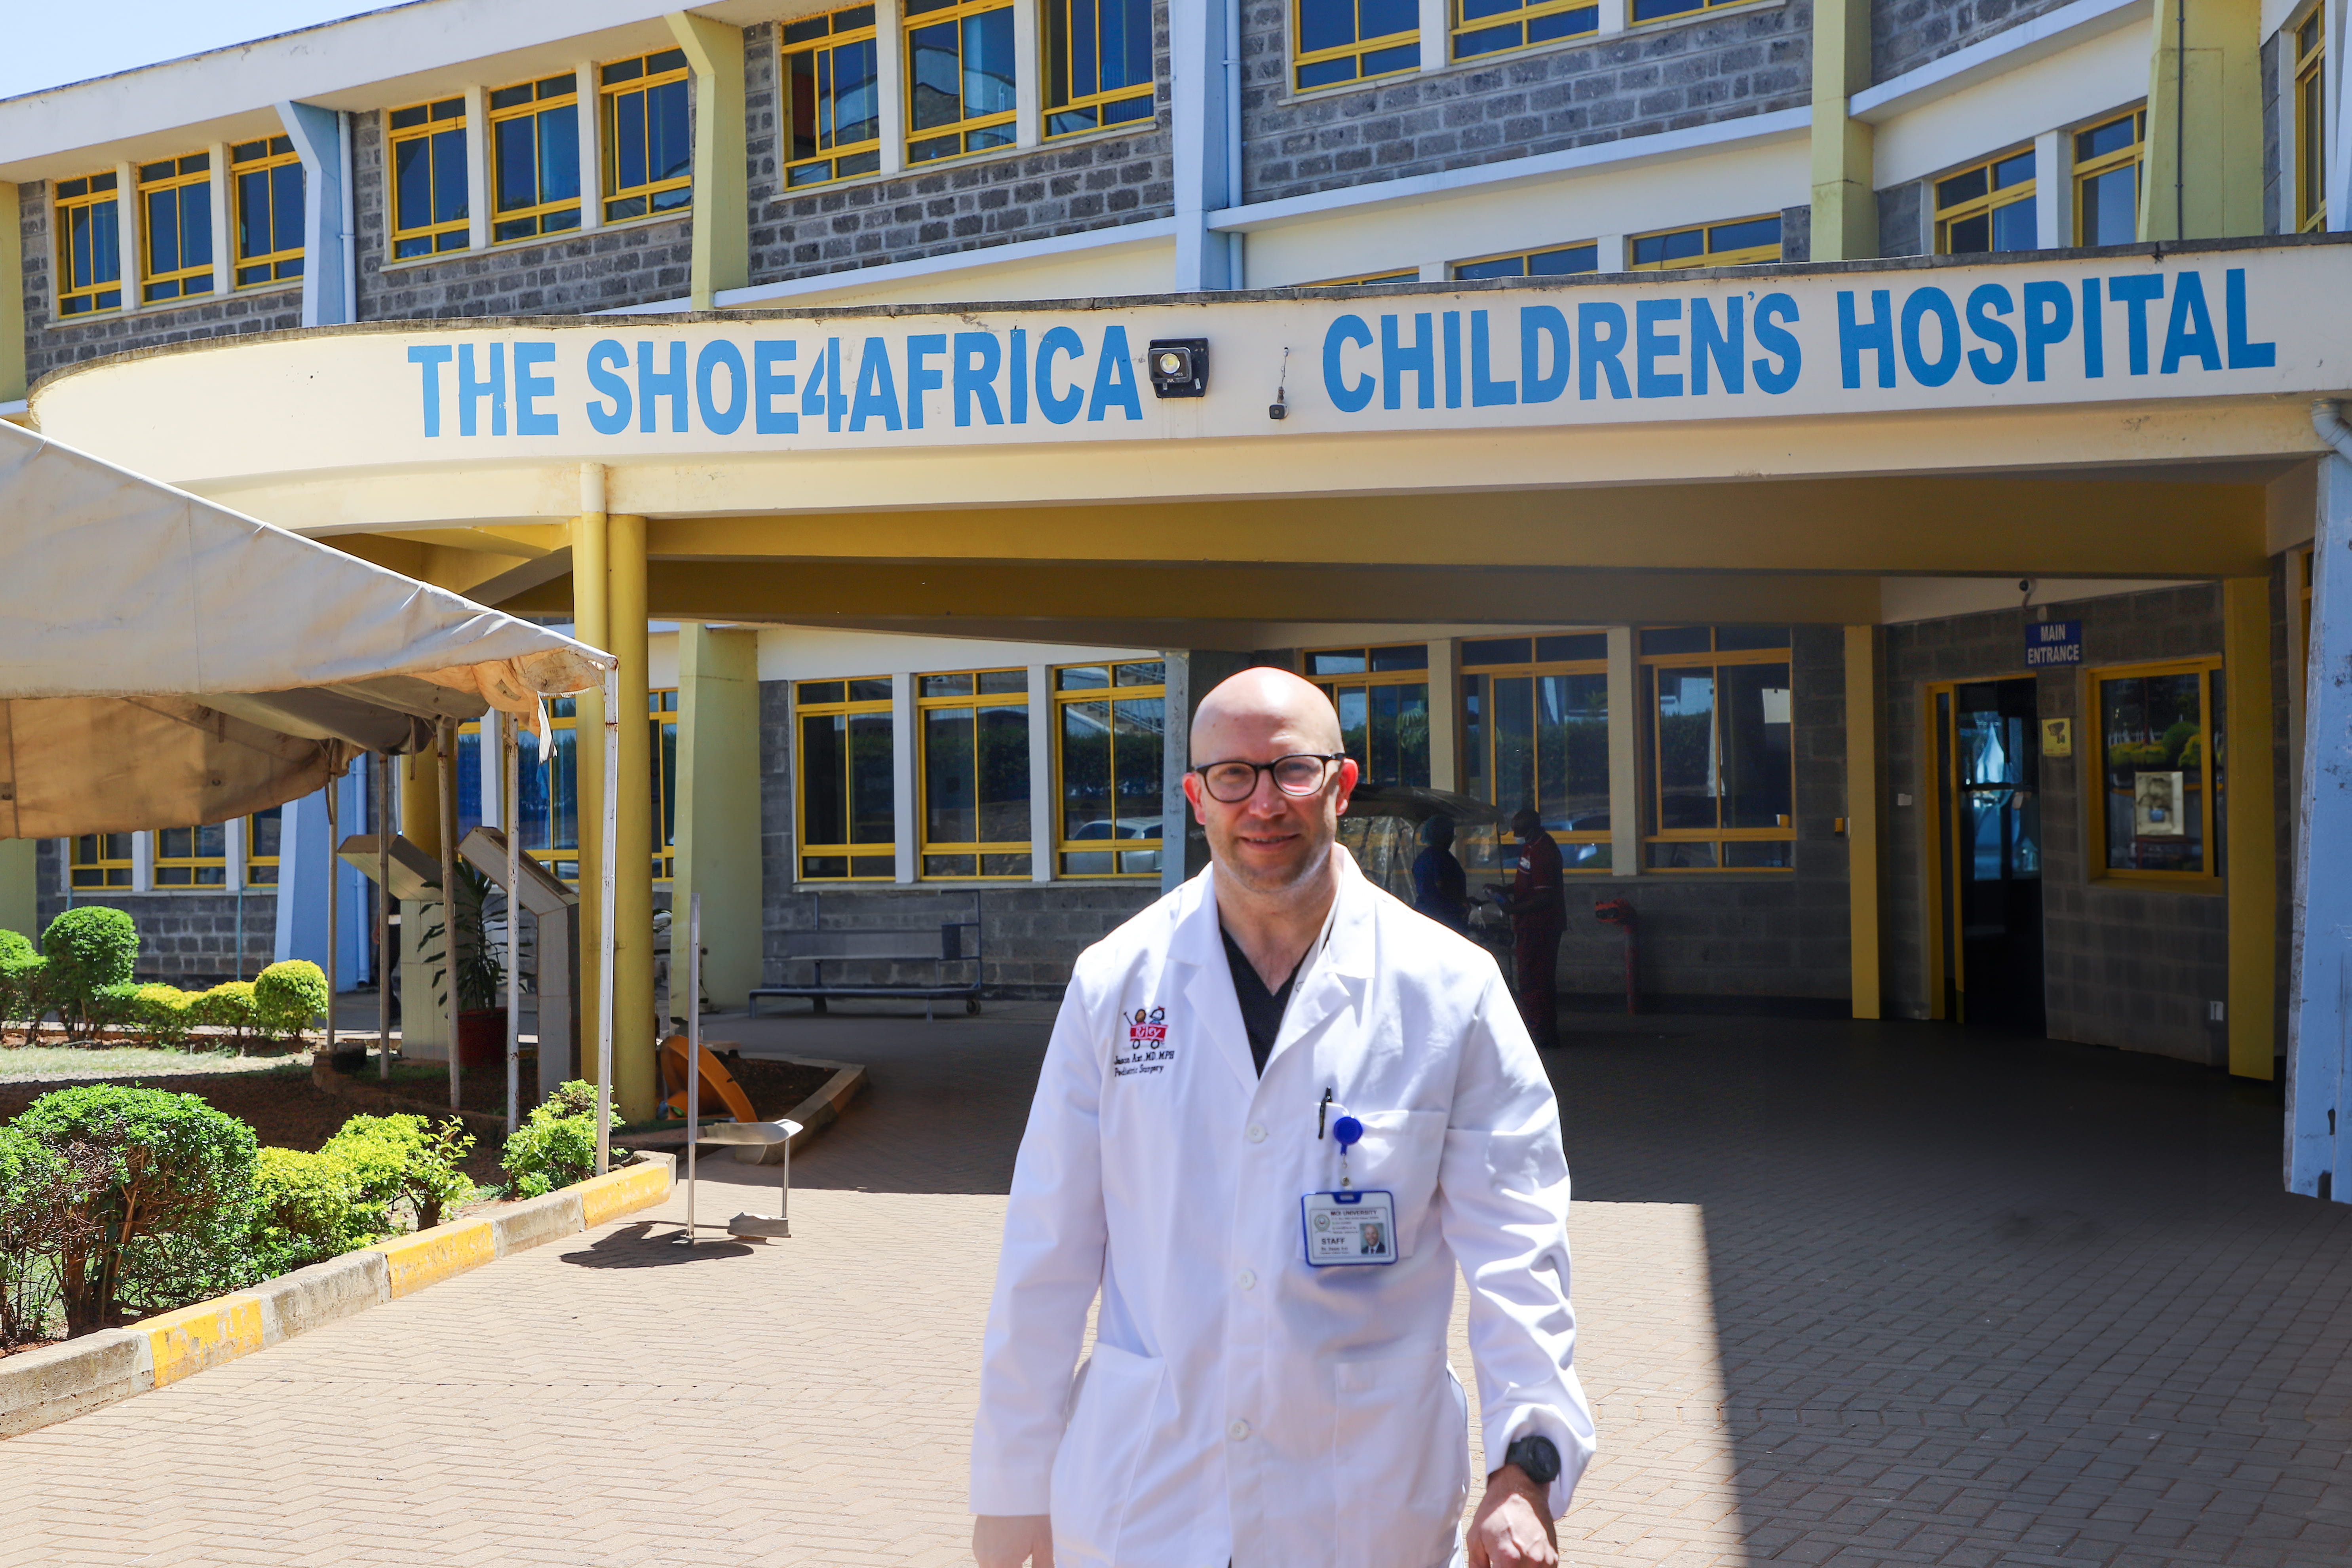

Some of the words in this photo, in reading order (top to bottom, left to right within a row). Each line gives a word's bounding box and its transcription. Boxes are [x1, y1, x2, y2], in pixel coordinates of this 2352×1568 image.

[408, 342, 558, 437] THE
[587, 325, 1143, 437] SHOE4AFRICA
[1323, 291, 1802, 412] CHILDREN'S
[1837, 268, 2276, 390] HOSPITAL
[2041, 624, 2066, 642] MAIN
[2028, 644, 2079, 664] ENTRANCE
